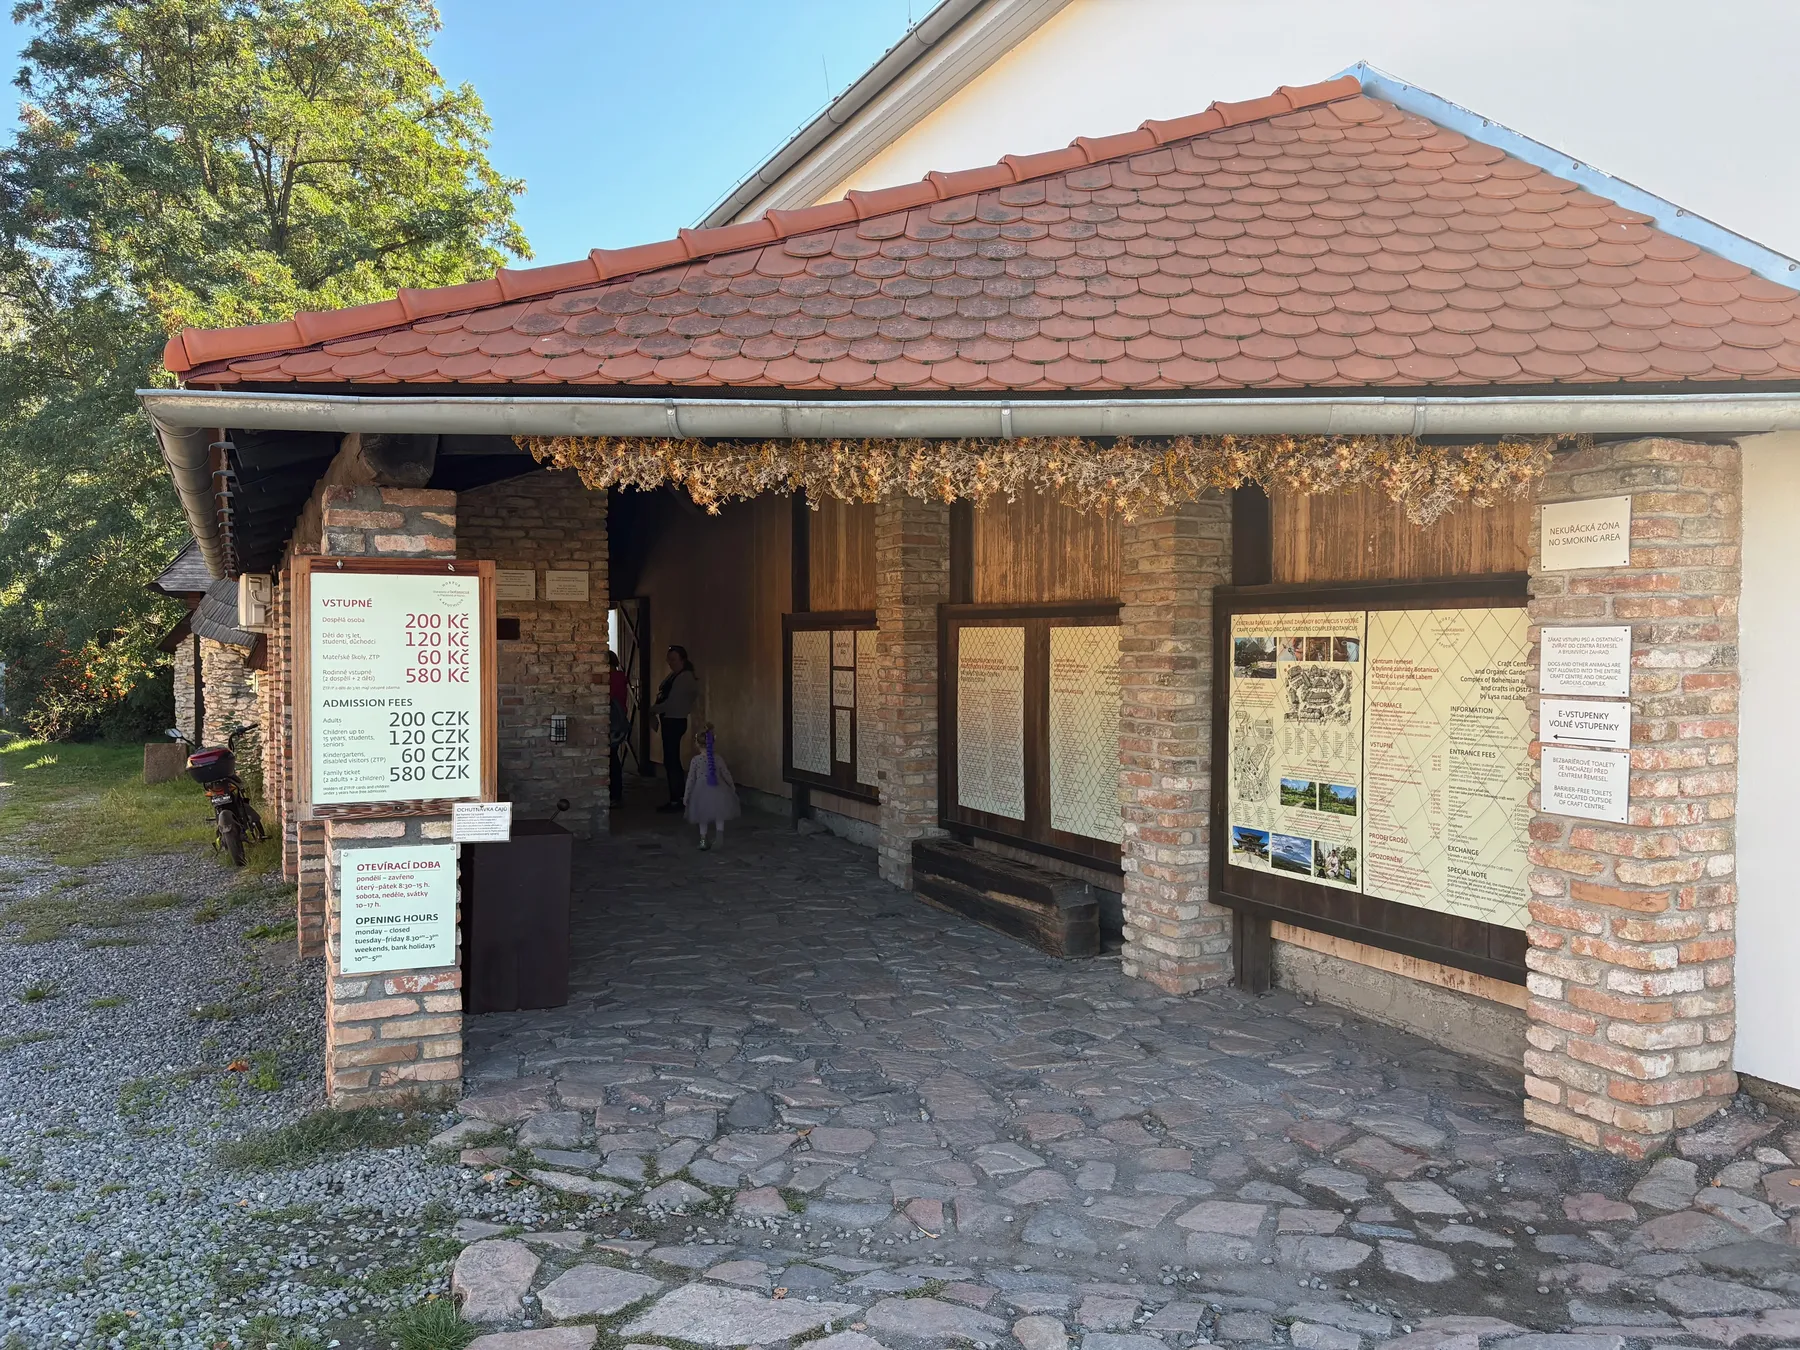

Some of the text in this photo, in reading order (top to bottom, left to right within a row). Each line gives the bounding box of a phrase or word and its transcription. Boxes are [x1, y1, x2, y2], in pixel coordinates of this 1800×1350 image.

[1549, 521, 1620, 535] NEKUŘÁCKÁ ZÓNA
[1548, 533, 1621, 546] NO SMOKING AREA
[322, 598, 373, 608] VSTUPNÉ
[322, 616, 346, 624] Dospělá
[405, 613, 469, 629] 200 Kč
[405, 631, 469, 647] 120 Kč
[417, 649, 469, 665] 60 Kč
[1497, 660, 1512, 668] Craft
[406, 667, 470, 683] 580 Kč
[1485, 668, 1508, 676] Organic
[1460, 675, 1484, 683] Complex
[1484, 676, 1491, 684] of
[1491, 676, 1520, 684] Bohemian
[1491, 685, 1508, 693] crafts
[1512, 693, 1526, 701] Labe
[322, 698, 413, 708] ADMISSION FEES
[1450, 705, 1493, 714] INFORMATION
[389, 710, 470, 727] 200 CZK
[1558, 710, 1610, 720] E-VSTUPENKY
[1548, 720, 1620, 731] VOLNÉ VSTUPENKY
[389, 728, 470, 745] 120 CZK
[402, 746, 470, 763] 60 CZK
[1449, 748, 1496, 759] ENTRANCE FEES
[370, 756, 387, 764] (ZTP)
[1552, 757, 1616, 768] BEZBARIÉROVÉ TOALETY
[390, 764, 470, 782] 580 CZK
[1557, 771, 1583, 779] CENTREM
[1593, 767, 1609, 775] PŘED
[1553, 784, 1613, 797] BARRIER-FREE TOILETS
[1564, 793, 1588, 801] LOCATED
[1588, 796, 1613, 804] OUTSIDE
[1369, 832, 1388, 842] PRODEJ
[1447, 845, 1479, 857] EXCHANGE
[356, 861, 441, 871] OTEVÍRACÍ DOBA
[1447, 866, 1487, 880] SPECIAL NOTE
[356, 875, 382, 883] pondělí
[406, 890, 429, 898] svátky
[355, 913, 439, 925] OPENING HOURS
[355, 928, 383, 936] monday
[389, 926, 410, 934] closed
[354, 945, 390, 953] weekends,
